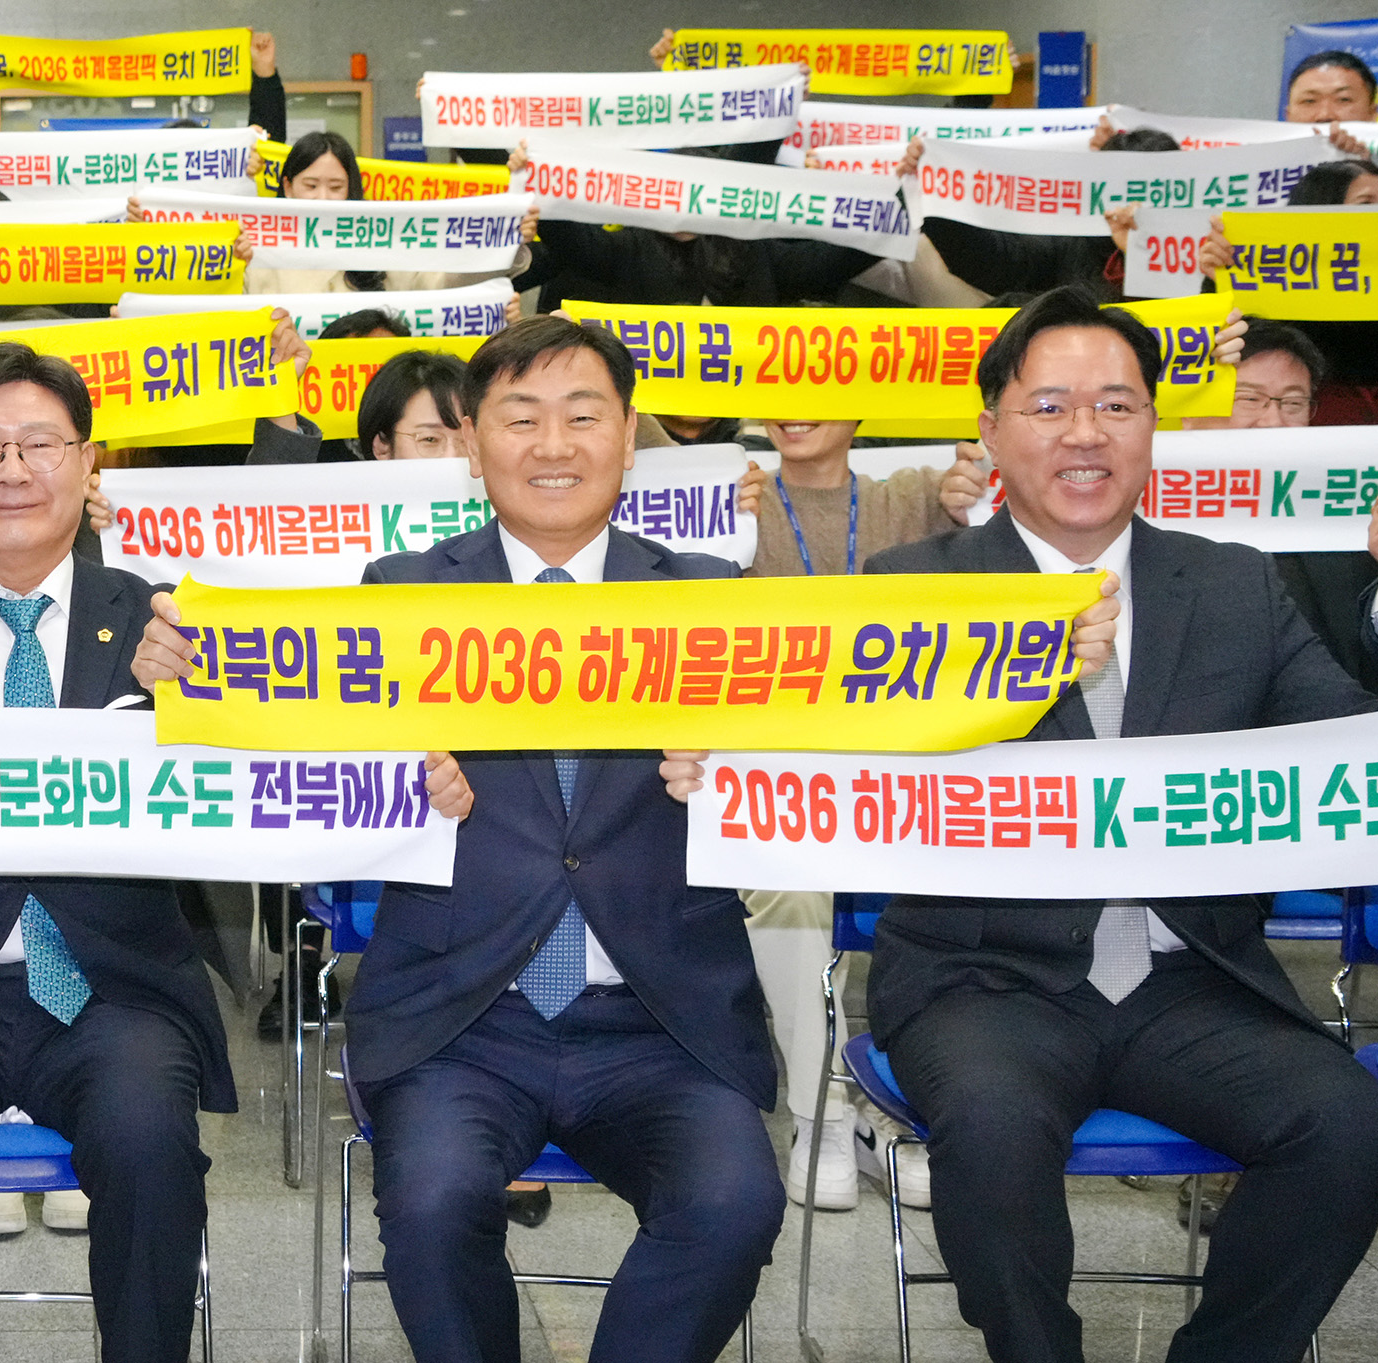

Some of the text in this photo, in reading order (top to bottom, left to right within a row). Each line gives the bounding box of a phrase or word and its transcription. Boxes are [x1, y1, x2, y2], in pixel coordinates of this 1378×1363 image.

[21, 57, 66, 81] 2036
[74, 55, 155, 78] 하계올림픽
[163, 52, 195, 80] 유치
[202, 45, 240, 75] 기원!
[758, 45, 808, 66] 2036
[817, 45, 911, 76] 하계올림픽
[919, 46, 952, 75] 유치
[962, 45, 1002, 74] 기원!
[437, 86, 793, 126] 2036 하계올림픽 K-문화의 수도 전북에서
[58, 154, 137, 184] K-문화의
[145, 153, 178, 182] 수도
[422, 178, 509, 200] 하계올
[919, 166, 964, 200] 036
[974, 171, 1081, 214] 하계올림픽
[1203, 175, 1249, 207] 수도
[1258, 165, 1313, 204] 전북
[523, 160, 908, 234] 2036 하계올림픽 K-문화의 수도 전북에서
[306, 216, 394, 248] K-문화의
[401, 217, 439, 248] 수도
[1147, 236, 1209, 274] 203
[19, 247, 125, 282] 하계올림픽
[136, 247, 175, 279] 유치
[187, 247, 233, 279] 기원!
[1226, 244, 1372, 294] 전북의 꿈,
[439, 304, 503, 335] 전북에
[145, 344, 198, 401] 유치
[701, 324, 741, 384] 꿈,
[757, 326, 857, 384] 2036
[867, 326, 994, 385] 하계올
[1135, 466, 1378, 518] 올림픽 K-문화
[117, 507, 204, 558] 2036
[213, 504, 371, 556] 하계올림픽
[382, 498, 489, 551] K-문화
[609, 484, 735, 540] 전북에서
[172, 621, 1074, 707] 전북의 꿈, 2036 하계올림픽 유치 기원!
[147, 761, 233, 829] 수도
[250, 760, 430, 829] 전북에서
[716, 767, 837, 843] 2036
[852, 770, 1077, 848] 하계올림픽
[1094, 766, 1301, 848] K-문화의
